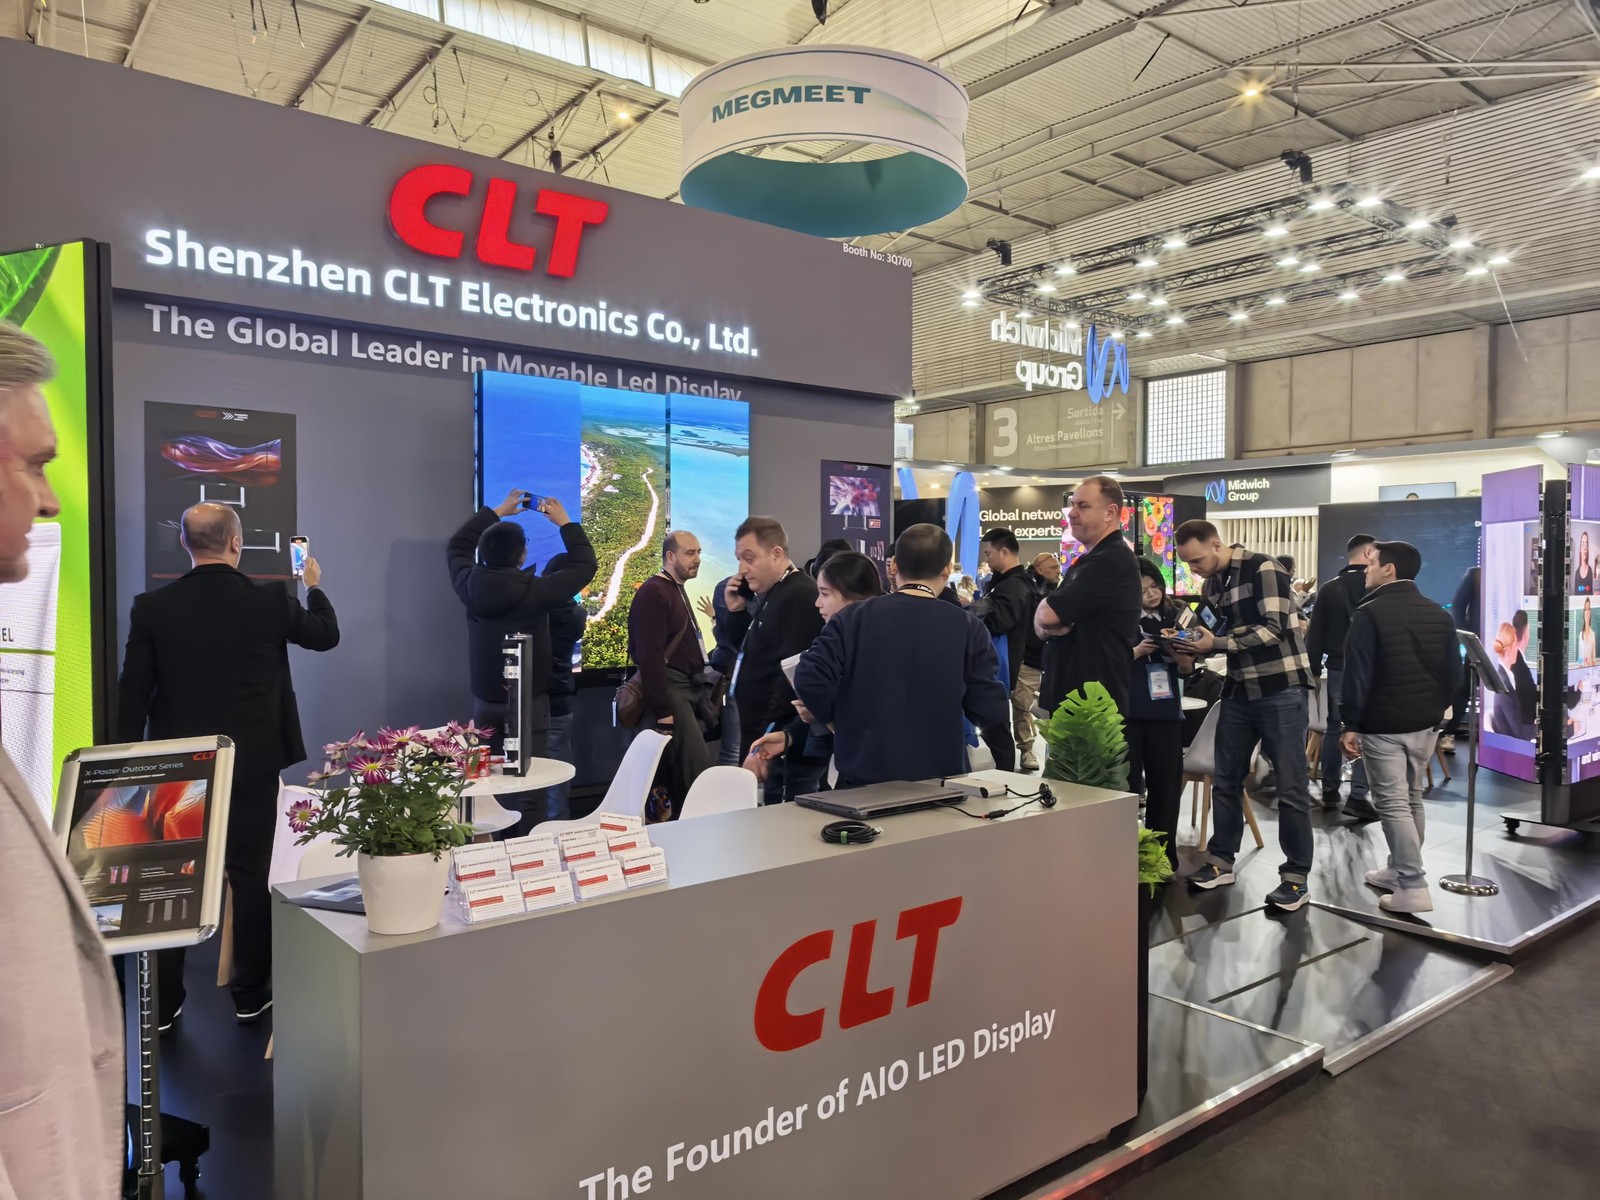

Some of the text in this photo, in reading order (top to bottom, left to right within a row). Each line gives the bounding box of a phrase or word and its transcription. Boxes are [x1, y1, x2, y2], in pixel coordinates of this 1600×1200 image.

[712, 85, 871, 123] MEGMEET
[388, 164, 609, 278] CLT
[843, 243, 912, 268] Booth No: 3Q700
[145, 229, 758, 357] Shenzhen CLT Electronics Co., Ltd.
[144, 303, 742, 400] The Global Leader in Movable Led Display
[1066, 405, 1104, 419] Sortida
[993, 407, 1018, 457] 3
[1026, 427, 1104, 445] Altres Pavellons
[1228, 478, 1270, 490] Midwich
[1228, 491, 1259, 503] Group
[979, 508, 1063, 521] Global netwo
[1014, 525, 1062, 539] experts
[0, 627, 14, 642] EL
[192, 752, 215, 761] CLT
[85, 762, 184, 777] X-Poster Outdoor Series
[754, 896, 963, 1052] CLT
[579, 1008, 1056, 1200] The Founder of AIO LED Display
